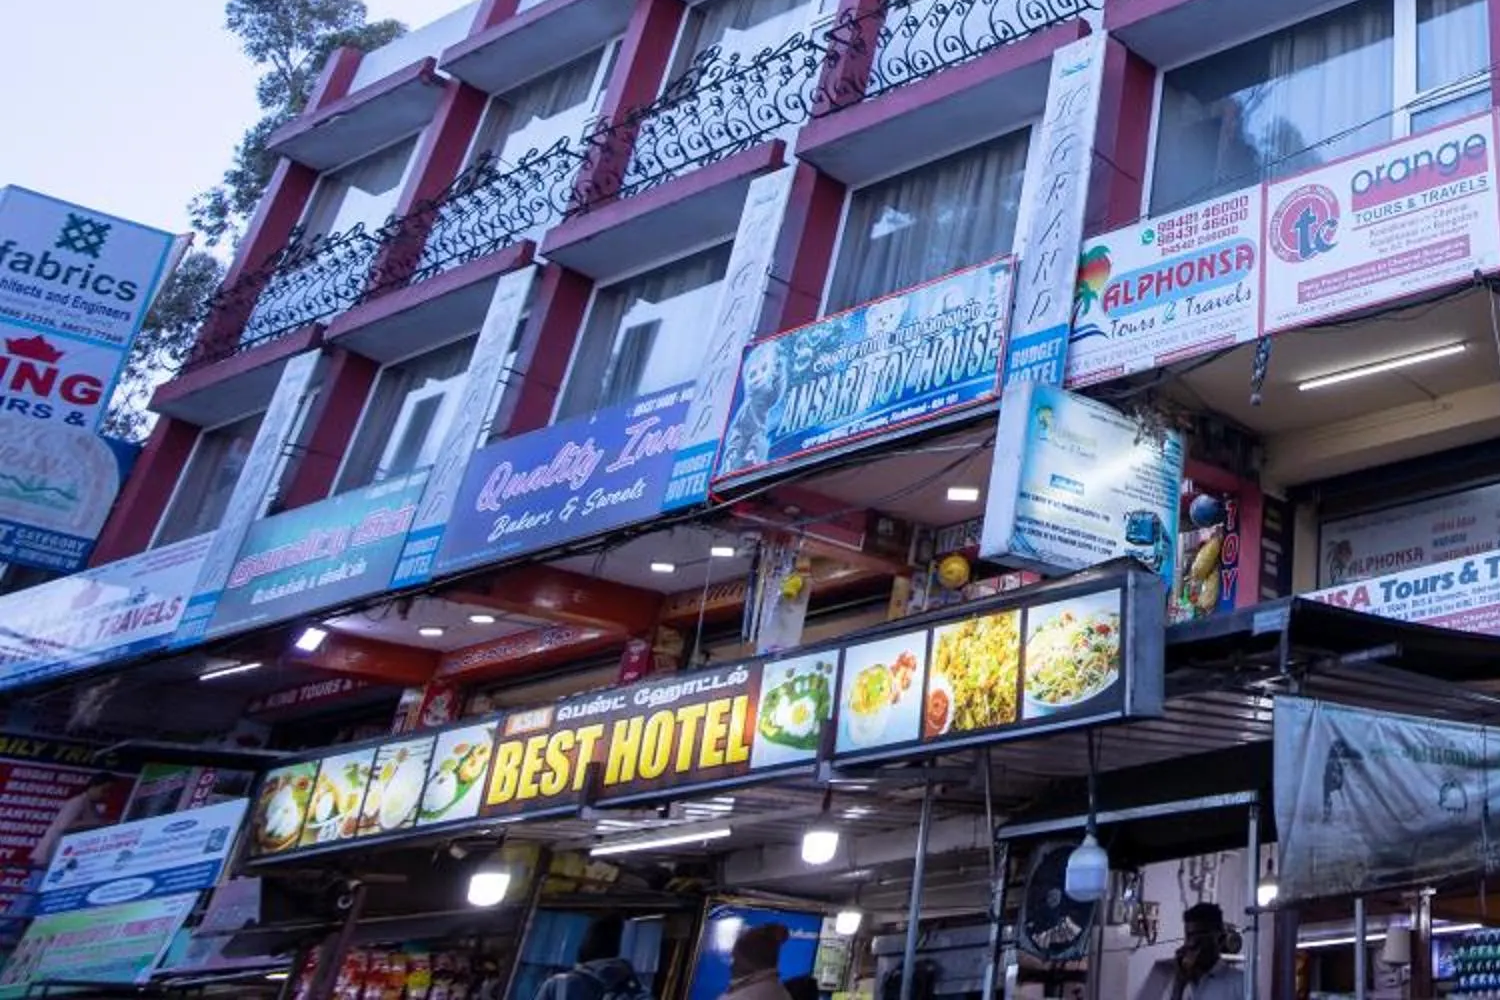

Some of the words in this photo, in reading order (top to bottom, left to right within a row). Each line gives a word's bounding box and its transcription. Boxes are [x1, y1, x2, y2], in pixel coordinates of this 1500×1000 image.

[1350, 133, 1488, 196] orange
[1355, 200, 1403, 224] TOURS
[1406, 197, 1417, 210] &
[1419, 175, 1488, 205] TRAVELS
[1102, 243, 1255, 313] ALPHONSA
[1185, 280, 1251, 318] Travels
[775, 358, 866, 437] ANSARI
[913, 320, 1001, 394] HOUSE
[64, 411, 88, 427] &
[476, 436, 604, 512] Quality
[1347, 546, 1425, 575] ALPHONSA
[1379, 570, 1456, 604] Tours
[1458, 560, 1479, 585] &
[487, 724, 605, 806] BEST
[604, 695, 750, 787] HOTEL
